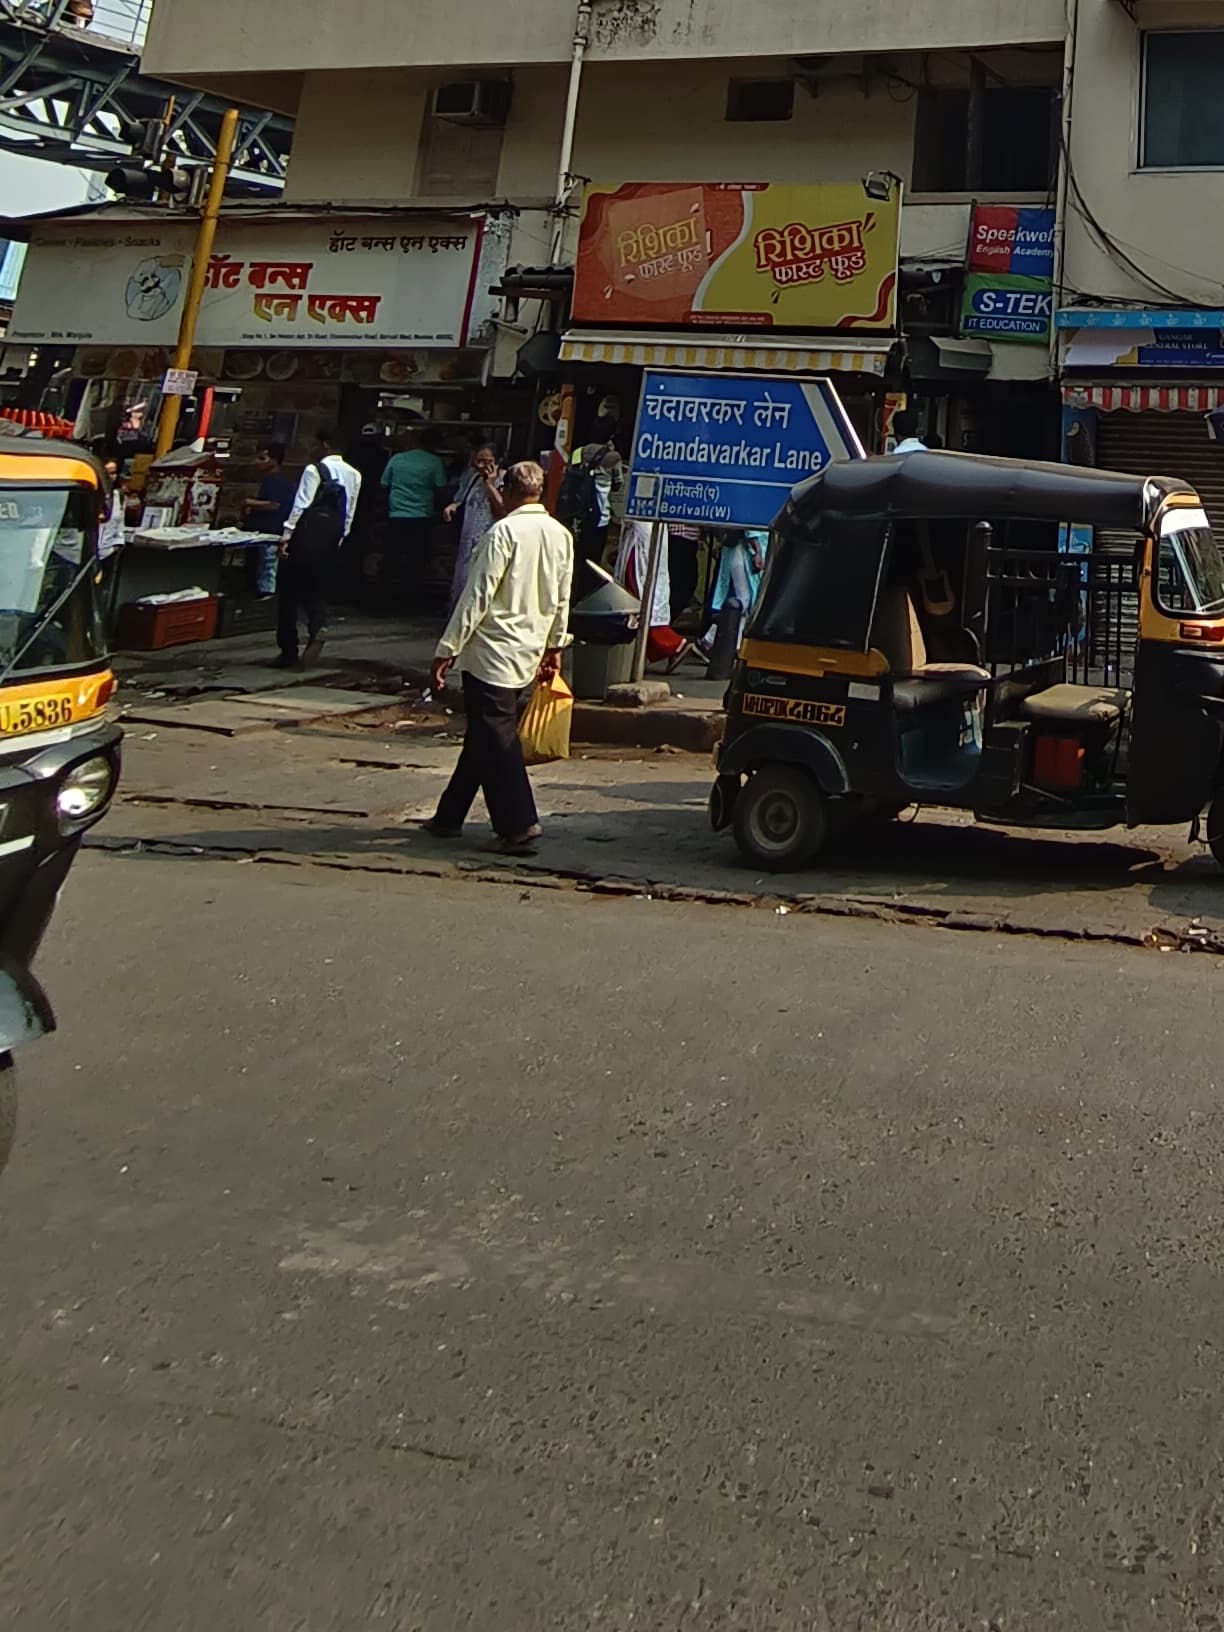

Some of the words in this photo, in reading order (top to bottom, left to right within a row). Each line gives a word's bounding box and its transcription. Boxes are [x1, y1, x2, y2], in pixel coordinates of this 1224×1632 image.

[329, 231, 358, 252] हॉट
[361, 235, 396, 251] बन्स
[428, 235, 467, 254] एक्स
[617, 218, 698, 268] रिशिका
[755, 221, 863, 267] रिशिका
[976, 225, 1054, 244] Speakwel
[975, 244, 1010, 256] English
[248, 262, 313, 290] बन्स
[774, 260, 821, 282] फास्ट
[831, 252, 865, 279] फूड
[254, 294, 302, 323] एन
[308, 295, 381, 324] एक्स
[979, 291, 1052, 315] S-TEK
[968, 318, 978, 328] IT
[980, 318, 1040, 331] EDUCATION
[646, 383, 747, 426] चंदावरकर
[753, 391, 792, 429] लेन
[638, 433, 771, 469] Chandavarkar
[774, 442, 822, 471] Lane
[660, 501, 731, 520] Borivali(W)
